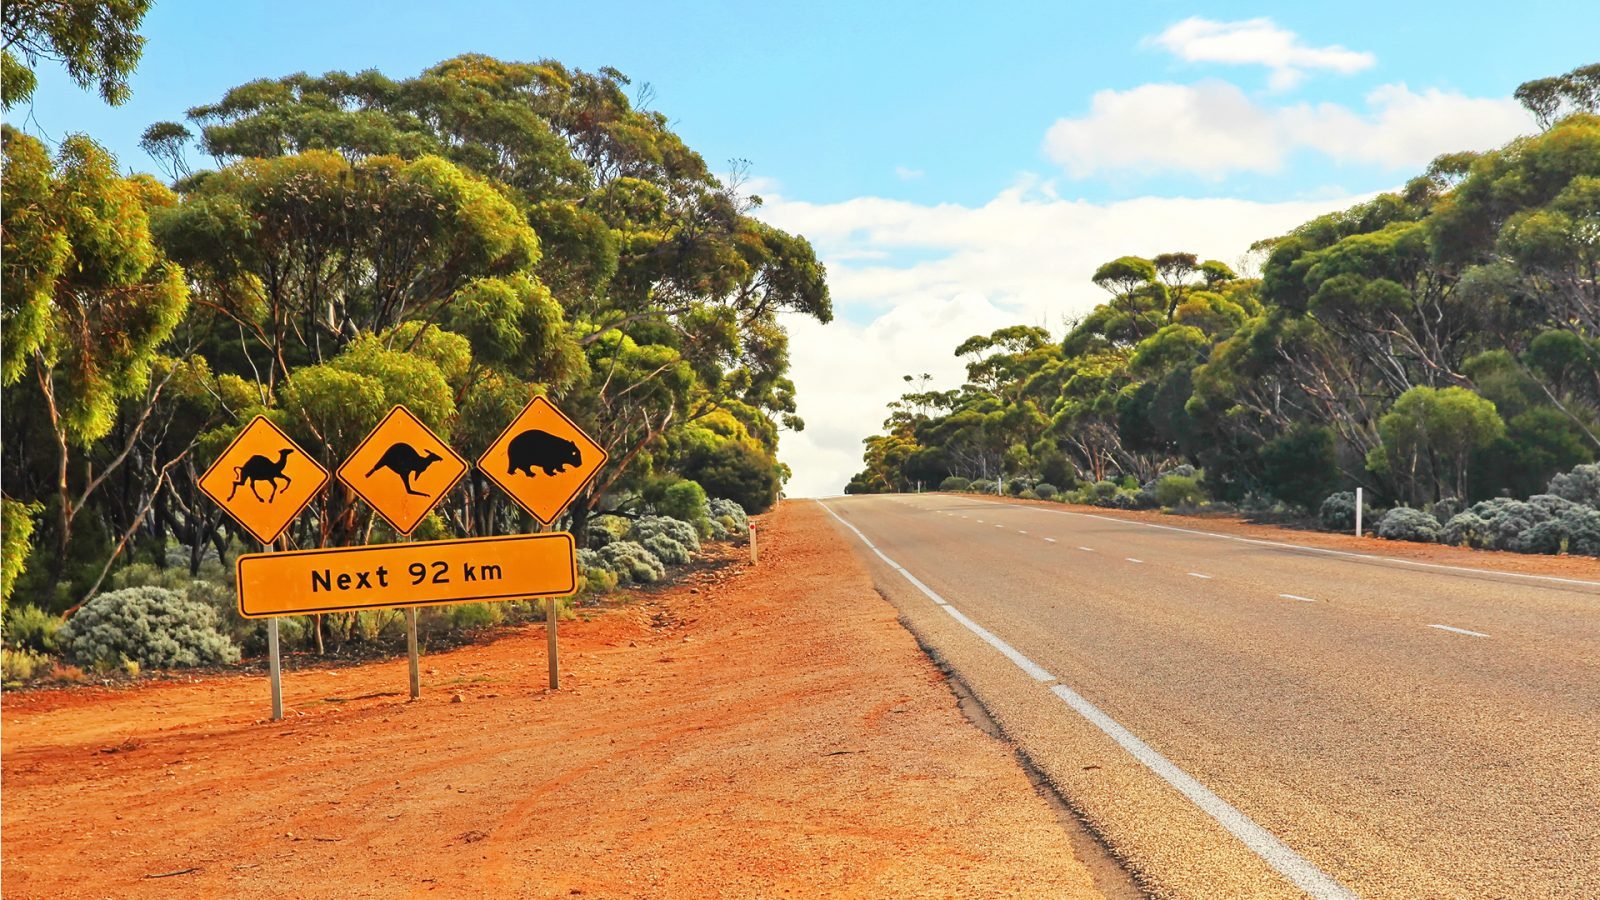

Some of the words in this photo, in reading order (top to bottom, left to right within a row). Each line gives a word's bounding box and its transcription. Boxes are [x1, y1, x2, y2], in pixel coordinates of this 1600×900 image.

[311, 566, 389, 593] Next
[408, 560, 450, 586] 92
[463, 562, 503, 582] km
